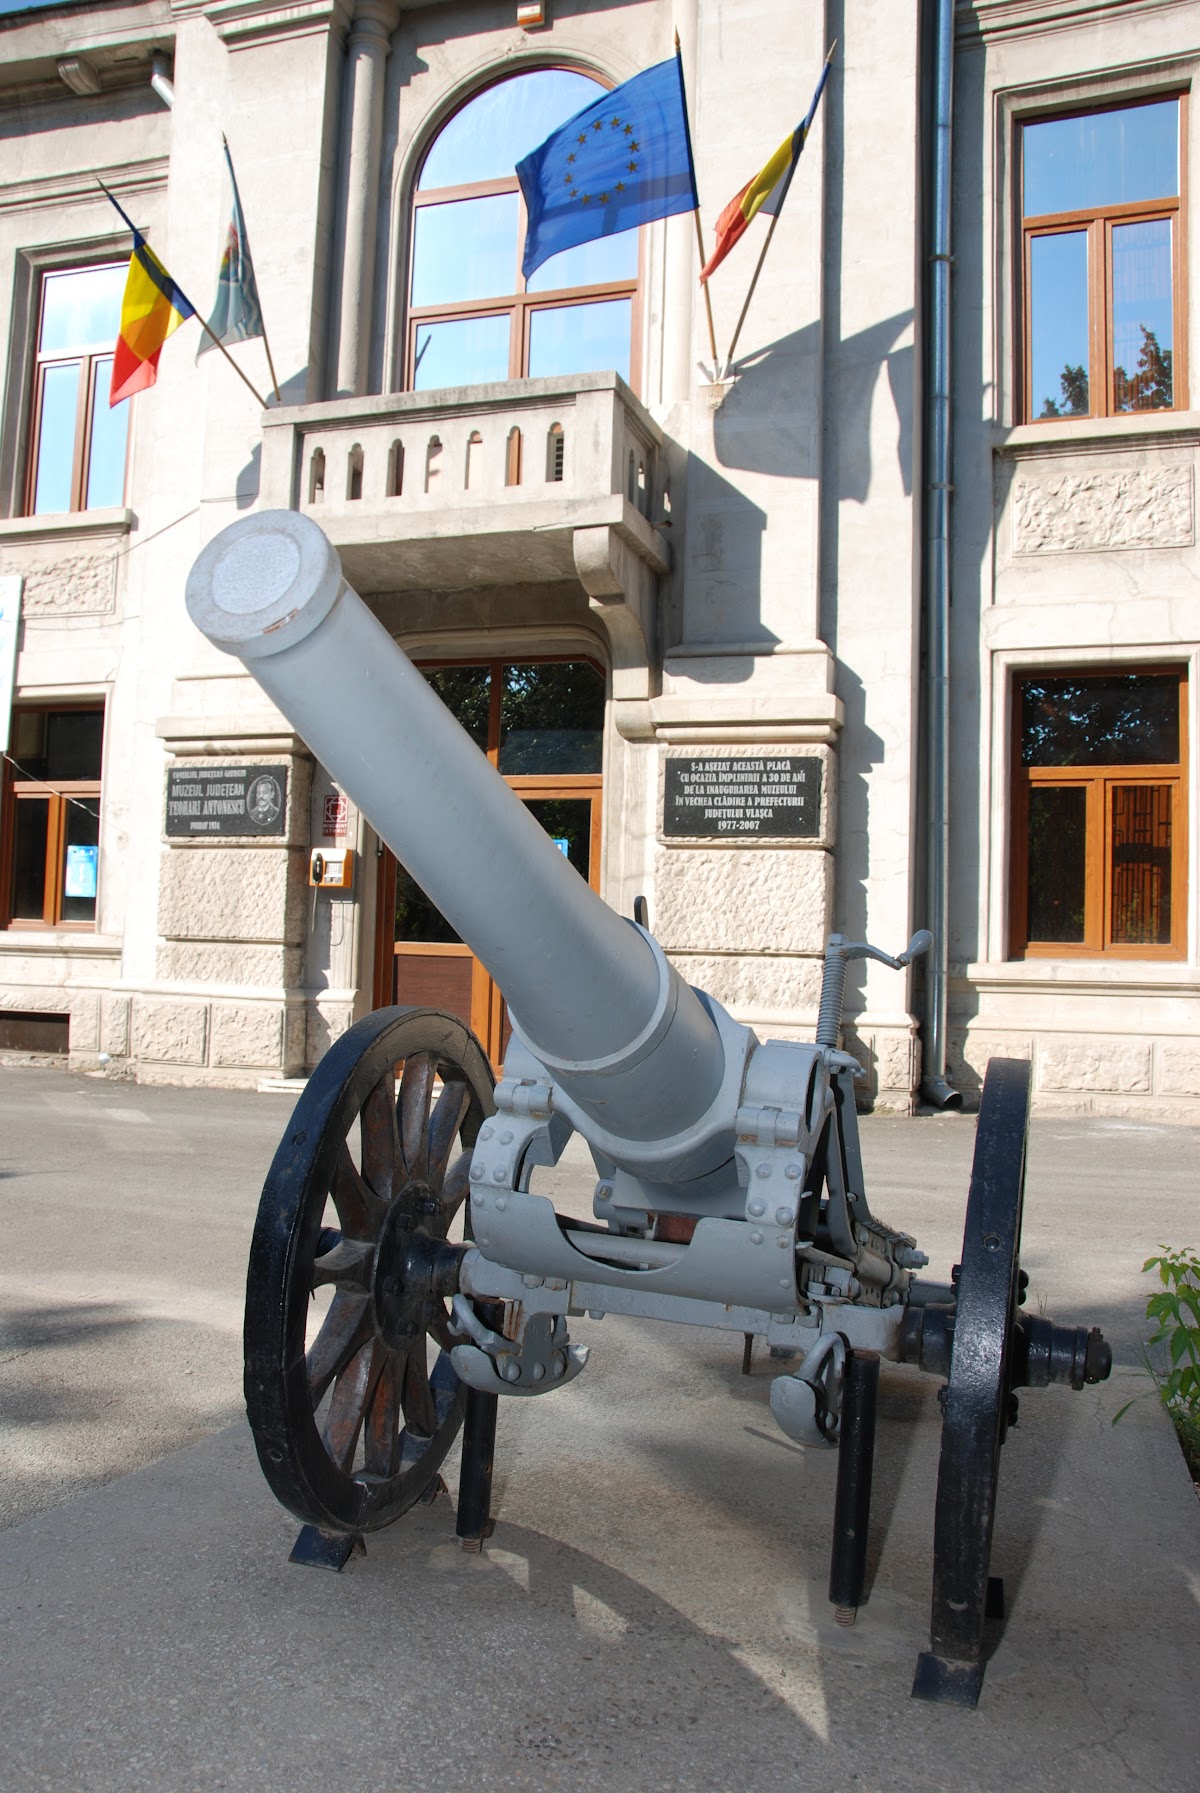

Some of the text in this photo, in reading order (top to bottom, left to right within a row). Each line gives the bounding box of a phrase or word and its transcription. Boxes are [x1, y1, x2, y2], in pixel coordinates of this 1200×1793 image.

[691, 759, 791, 772] S-A AȘEZAT ACEASTĂ PLACĂ
[680, 772, 806, 783] CU OCAZIA ÎMPLINIRII A 30 DE ANI
[171, 783, 245, 797] MUZEUL JUDEȚEAN
[684, 784, 797, 795] DE LA INAUGURAREA MUZEULUI
[675, 795, 804, 806] ÎN VECHEA CLĂDIRE A PREFECTURII
[168, 799, 246, 816] TEOHARI ANTONESCU
[704, 808, 774, 819] JUDEȚULUI VLAȘCA
[717, 820, 760, 830] 1977-2007
